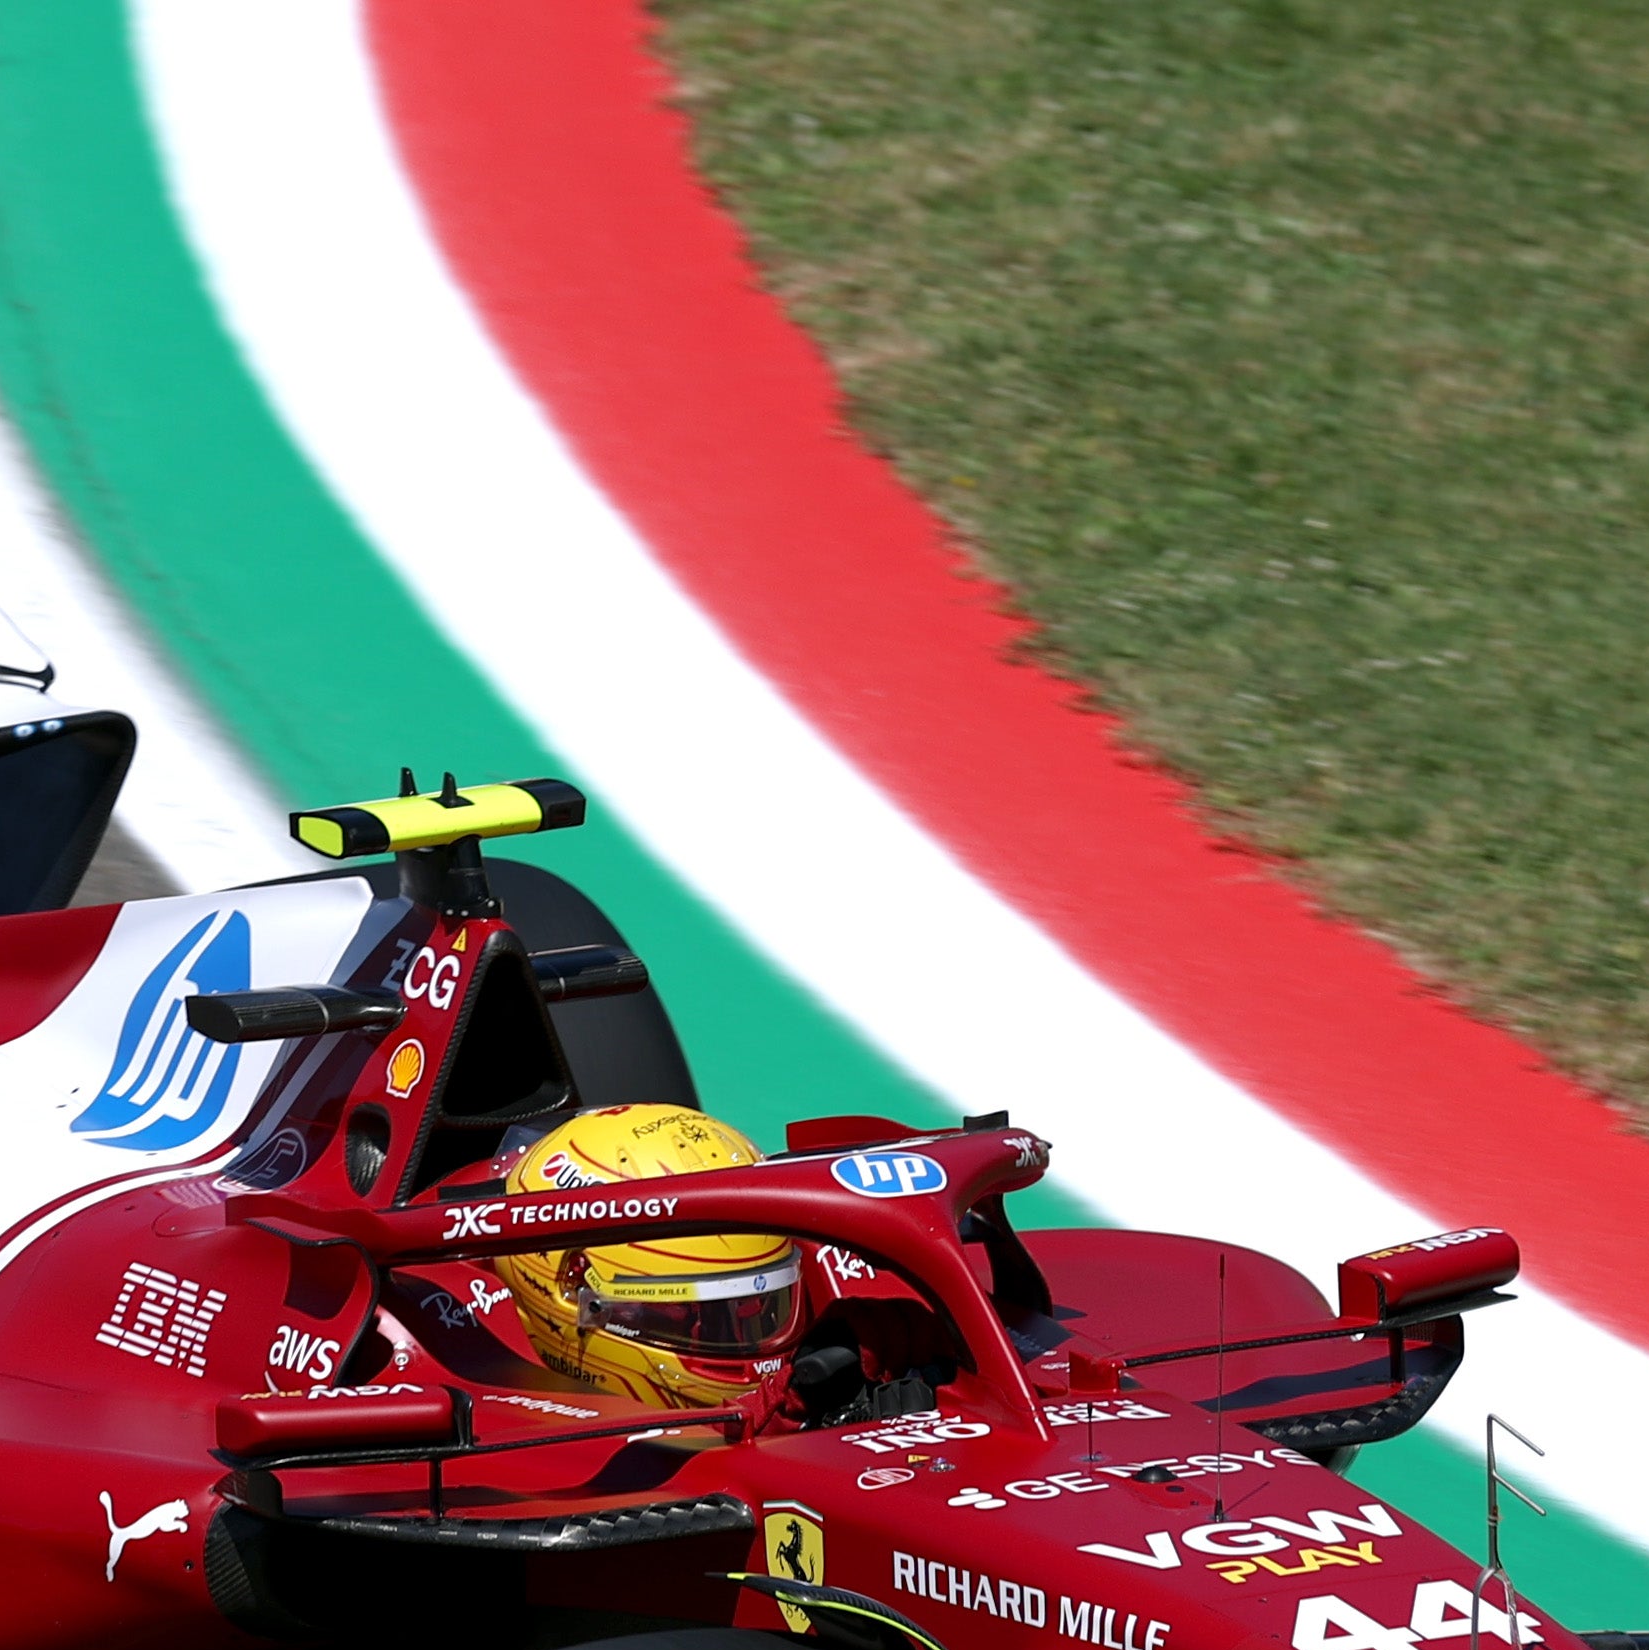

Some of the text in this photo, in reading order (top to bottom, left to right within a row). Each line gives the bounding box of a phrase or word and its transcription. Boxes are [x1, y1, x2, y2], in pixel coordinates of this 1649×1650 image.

[841, 1153, 938, 1194] hp
[510, 1197, 679, 1225] TECHNOLOGY
[95, 1262, 228, 1378] IBM
[269, 1325, 340, 1380] aws
[753, 1358, 782, 1375] VGW
[1077, 1504, 1403, 1570] VGW
[1205, 1540, 1384, 1583] PLAY
[893, 1550, 1046, 1629] RICHARD
